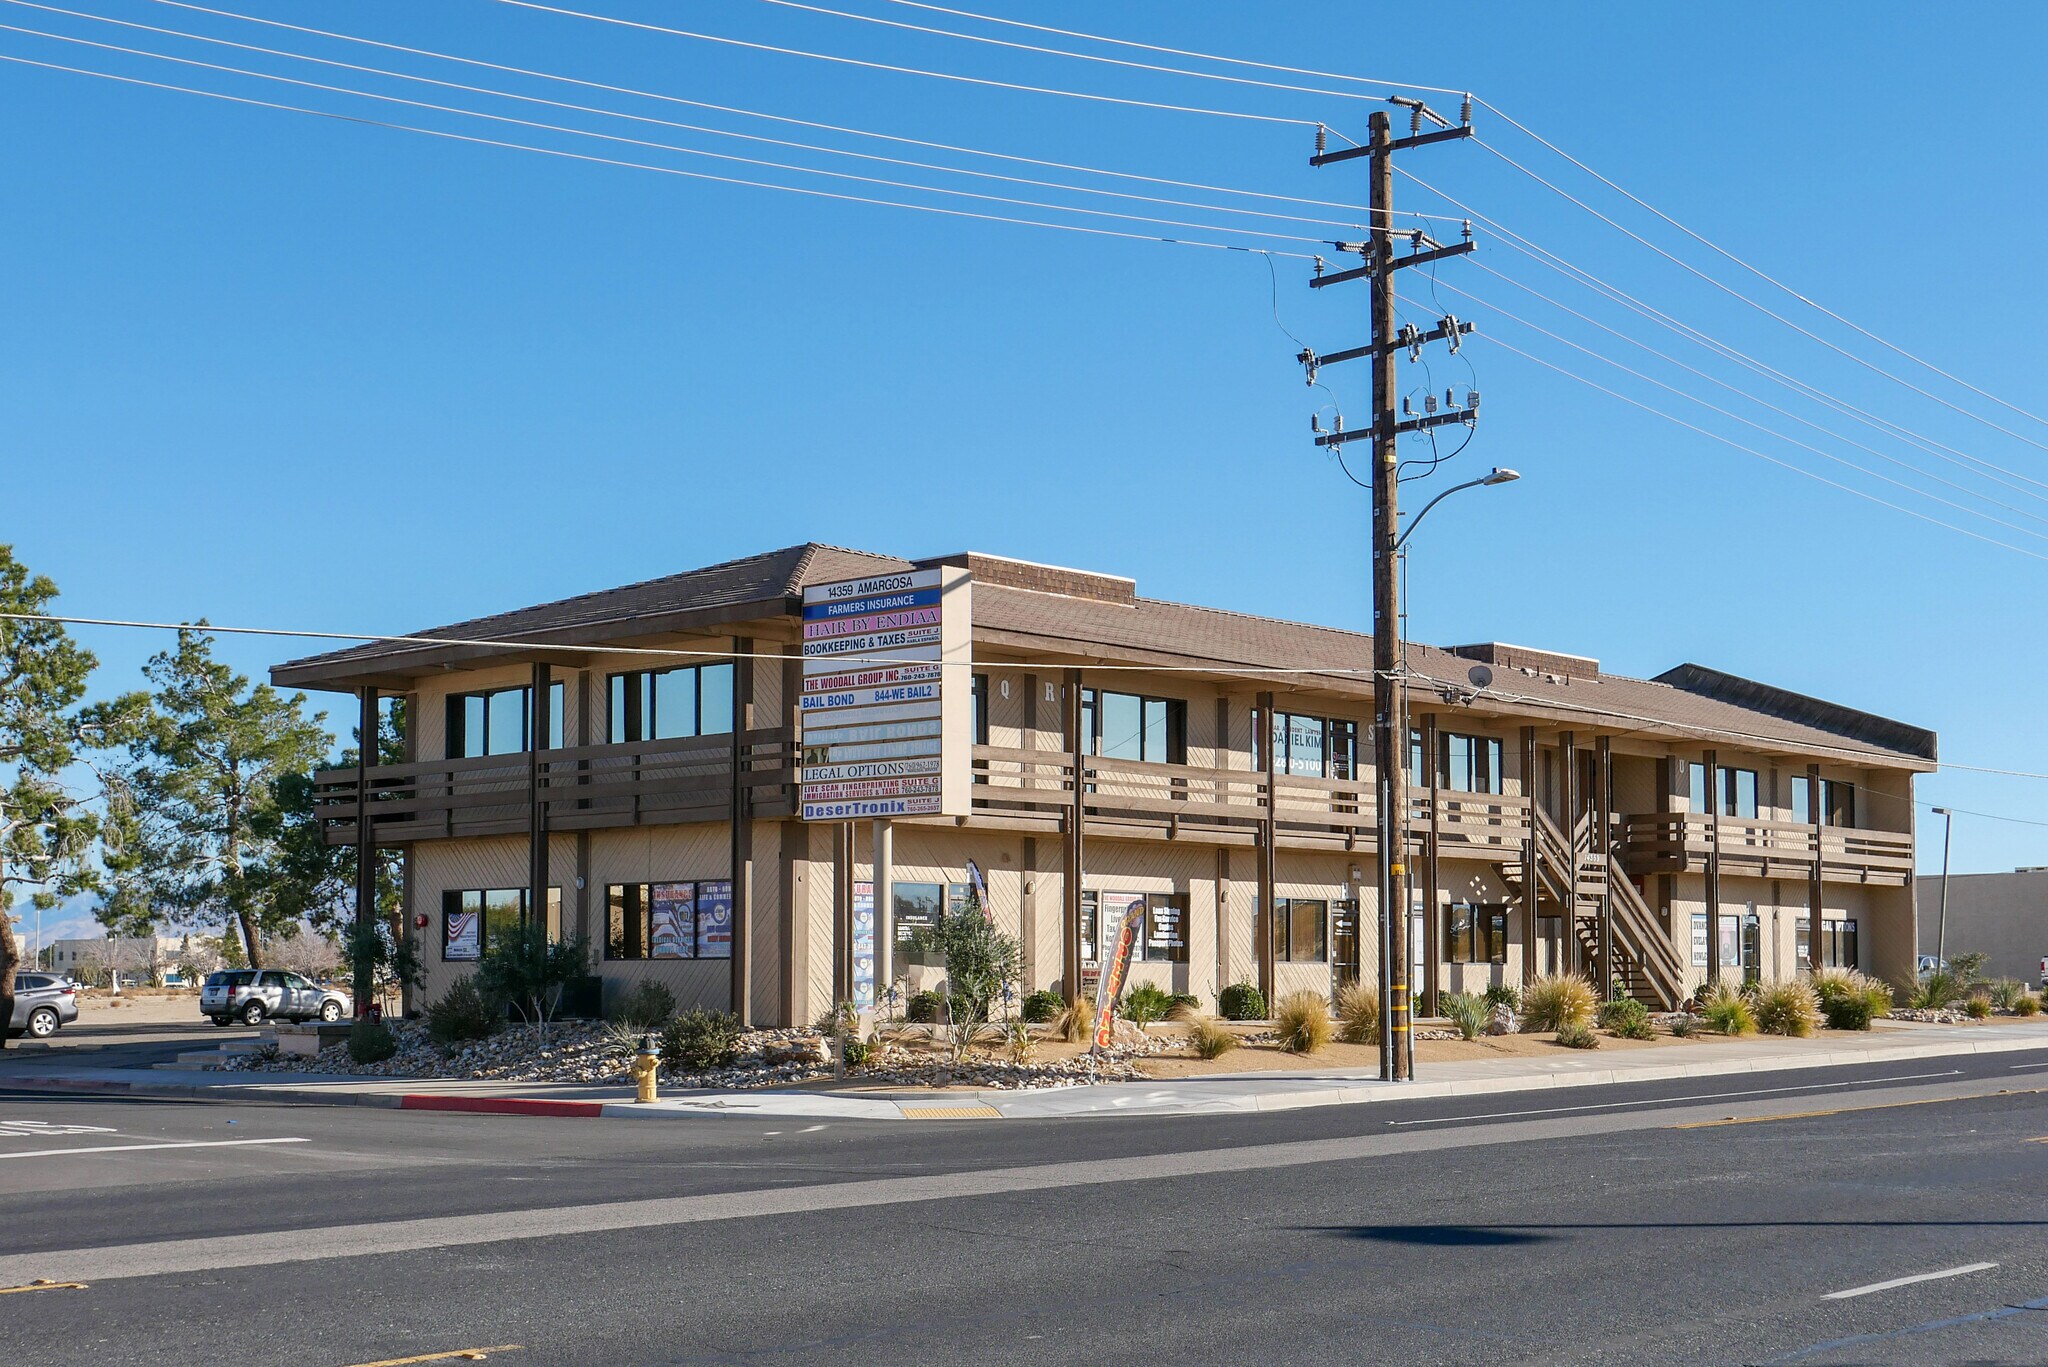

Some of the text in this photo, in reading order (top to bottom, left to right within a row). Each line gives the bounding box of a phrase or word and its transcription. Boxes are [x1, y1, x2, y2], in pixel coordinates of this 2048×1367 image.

[828, 576, 912, 598] 14359 AMARGOSA
[828, 595, 914, 615] FARMERS INSURANCE
[809, 610, 938, 636] HAIR BY ENDIAA
[804, 633, 906, 656] BOOKKEEPING & TAXES
[806, 679, 818, 690] THE
[820, 675, 855, 689] WOODALL
[858, 672, 883, 685] GROUP
[1000, 680, 1010, 699] Q
[803, 686, 932, 708] BAIL BOND 844-WE BAIL2
[1044, 682, 1054, 702] R
[1305, 735, 1322, 748] KIM
[804, 766, 844, 780] LEGAL
[847, 762, 904, 777] OPTIONS
[842, 780, 899, 790] FINGERPRINTING
[902, 778, 928, 786] SUITE
[804, 791, 843, 800] IMMIGRATION
[845, 789, 873, 797] SERVICES
[805, 800, 905, 818] DeserTronix
[652, 889, 692, 900] INSURANCE
[1822, 921, 1833, 932] GAL
